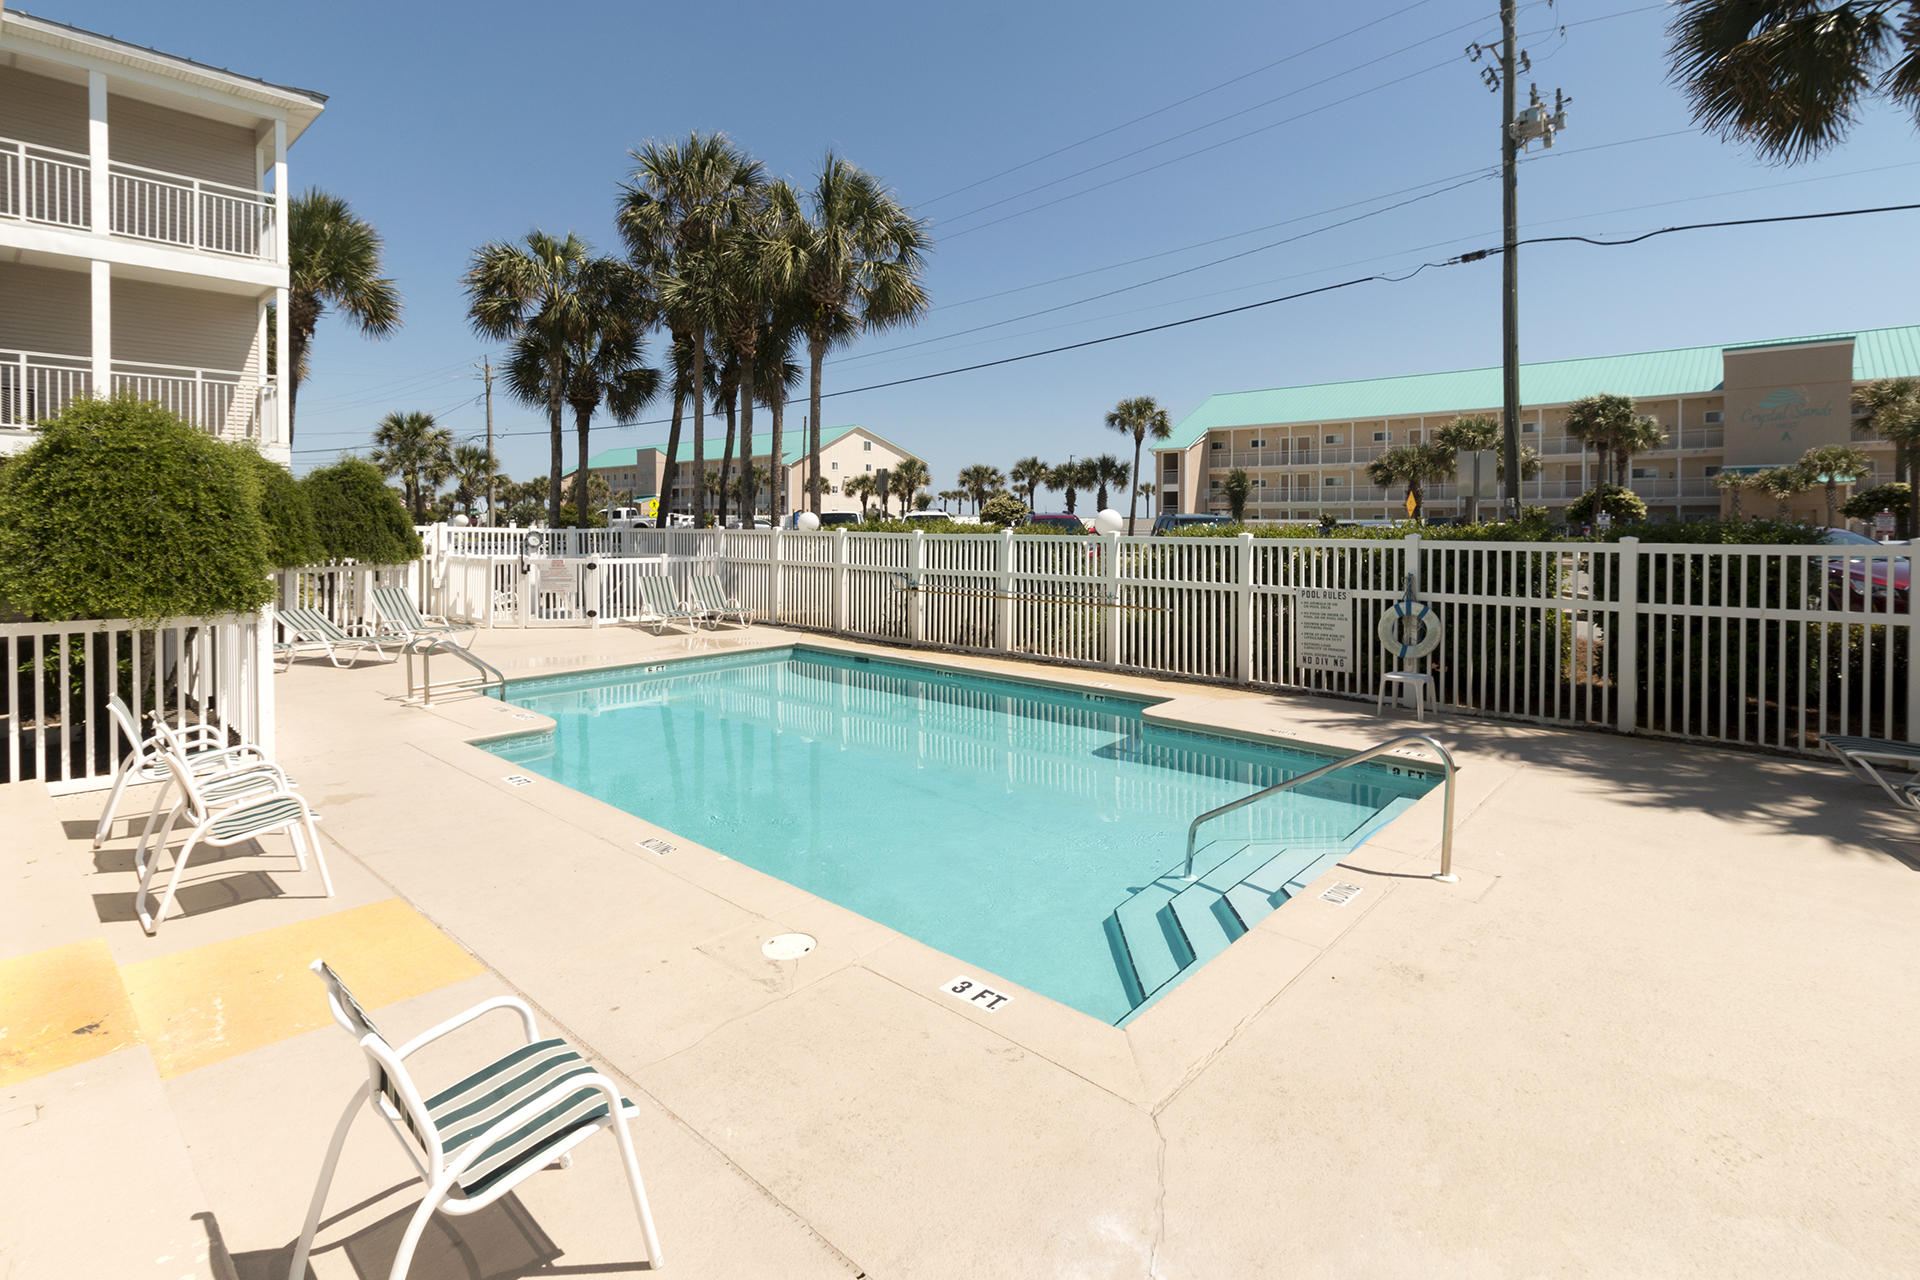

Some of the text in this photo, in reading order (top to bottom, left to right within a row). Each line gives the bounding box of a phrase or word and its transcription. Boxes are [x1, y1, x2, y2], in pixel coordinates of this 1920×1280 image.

[1301, 590, 1347, 600] POOL RULES
[1302, 656, 1312, 665] NO
[951, 981, 973, 994] 3
